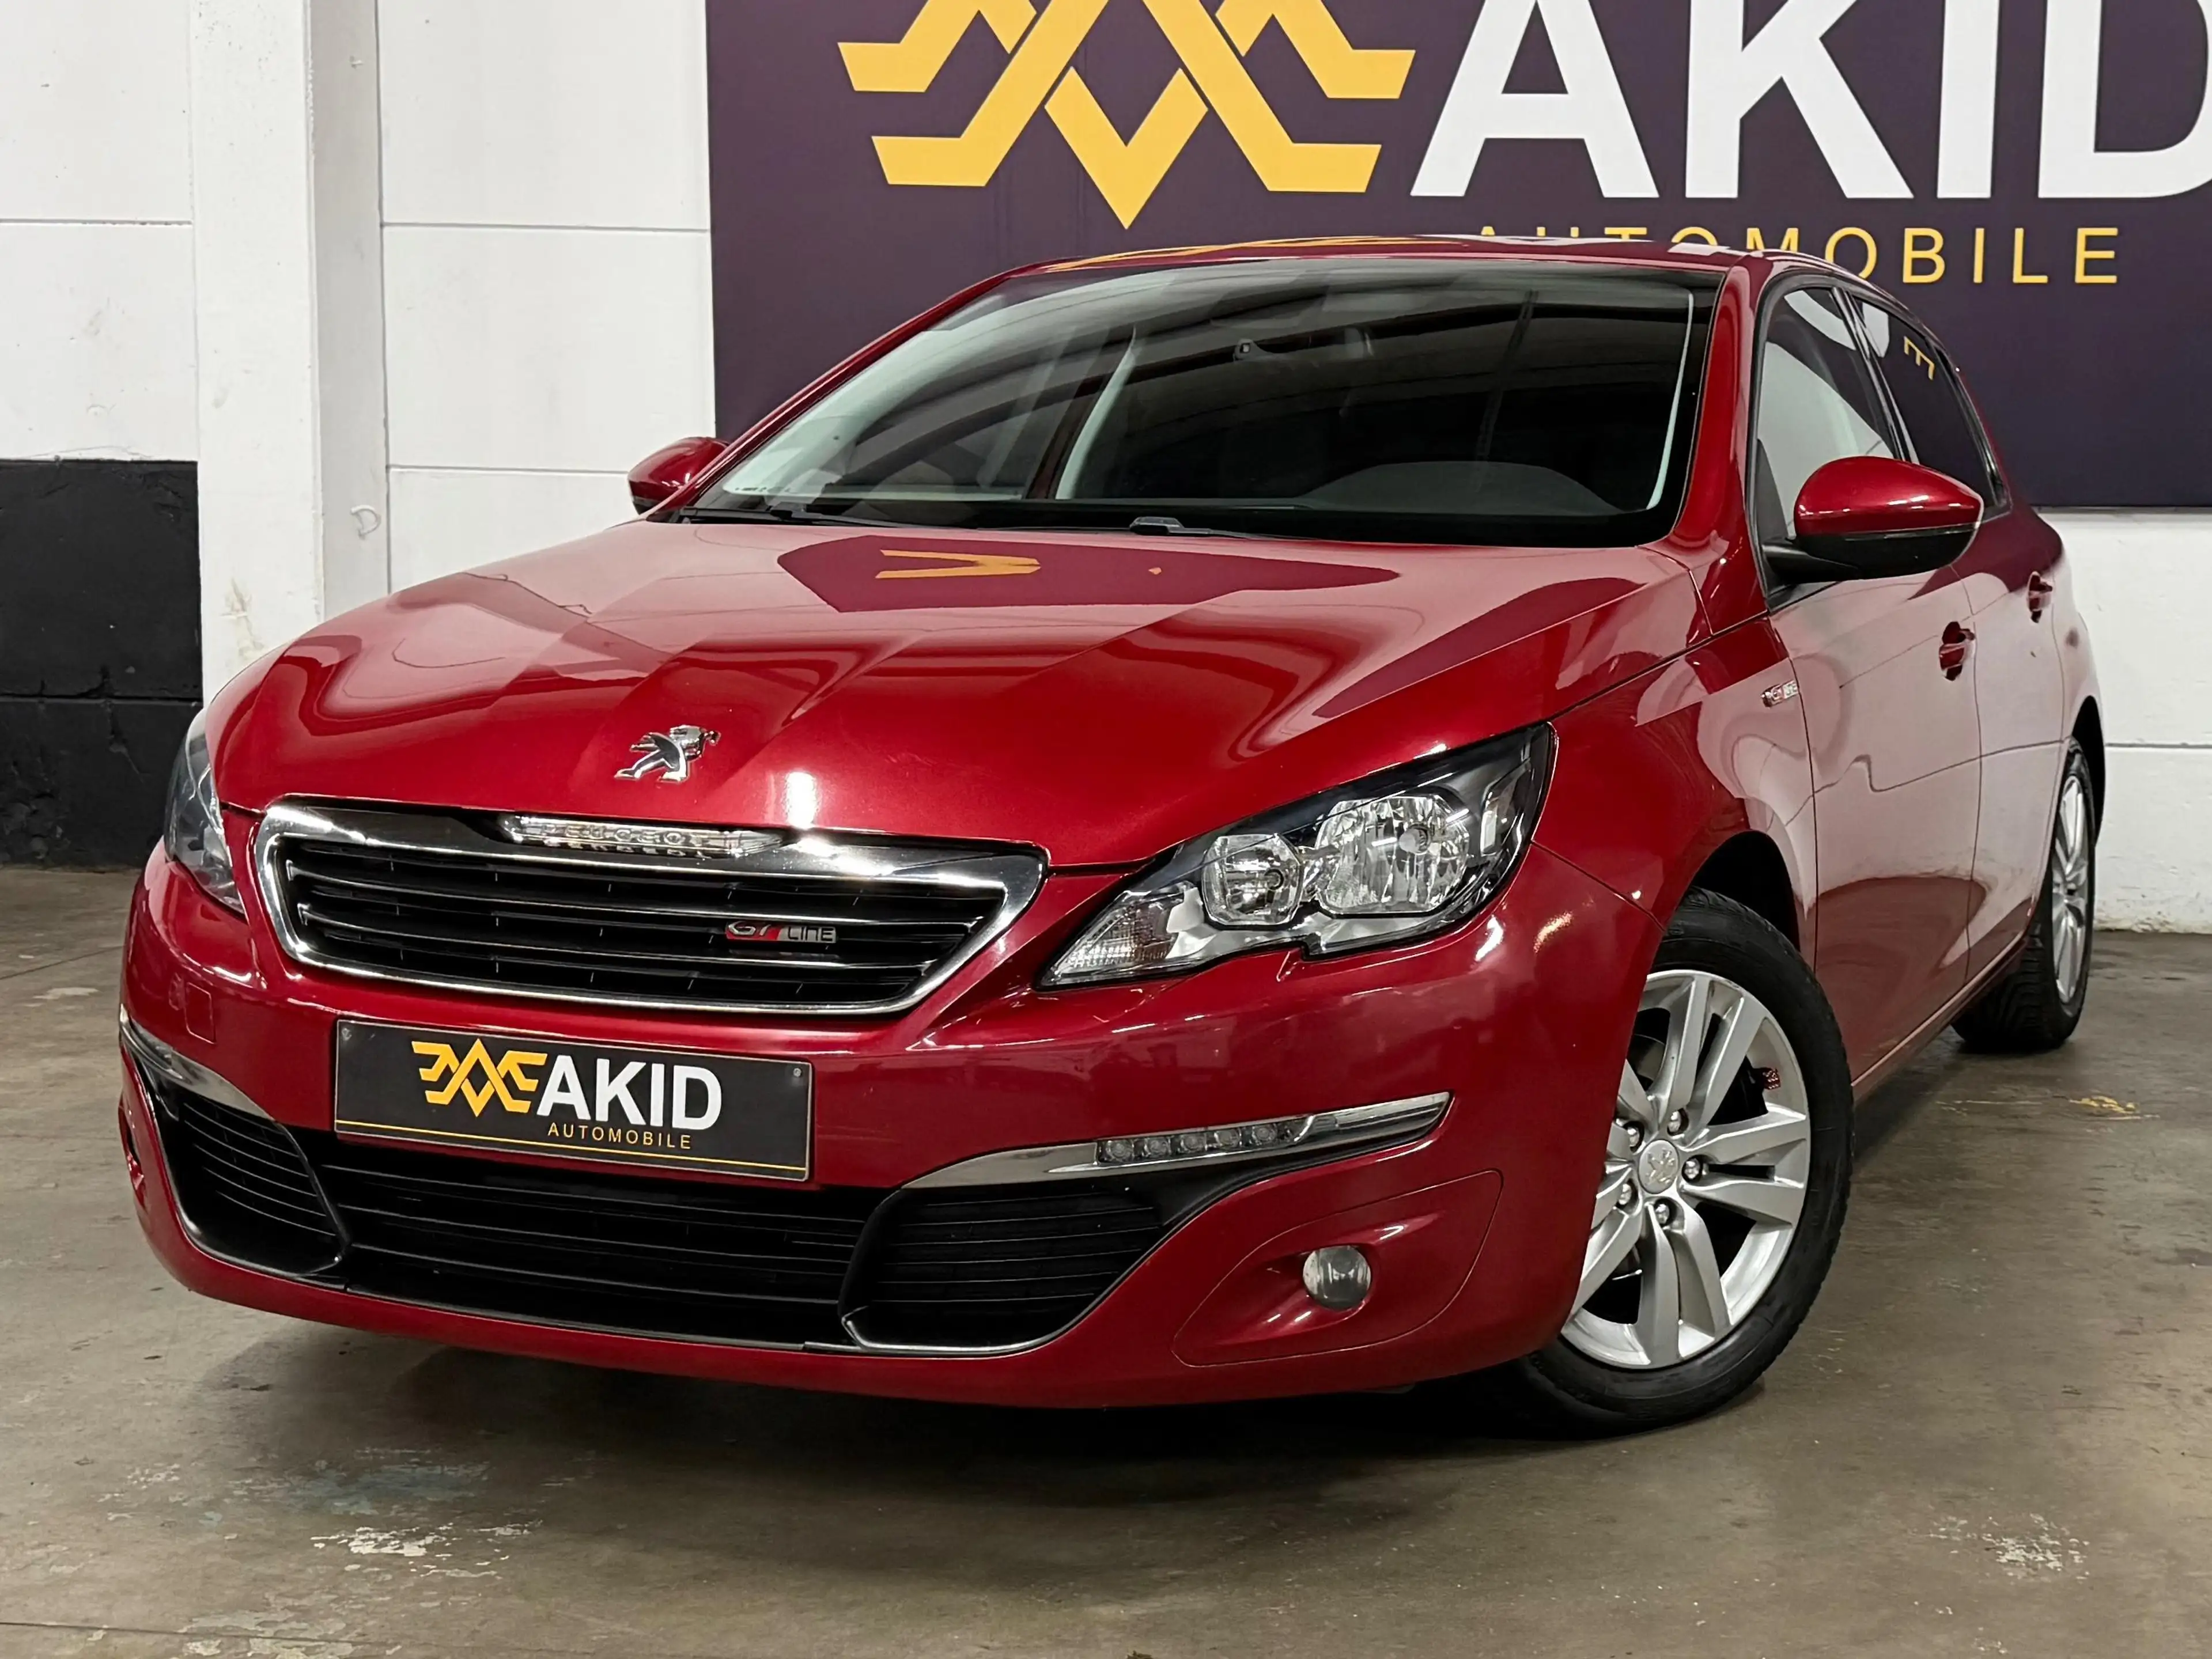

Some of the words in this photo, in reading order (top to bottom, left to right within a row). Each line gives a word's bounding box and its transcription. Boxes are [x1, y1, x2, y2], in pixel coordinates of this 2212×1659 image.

[1411, 0, 2212, 199] AKID
[536, 1055, 722, 1130] AKID
[548, 1122, 691, 1150] AUTOMOBILE
